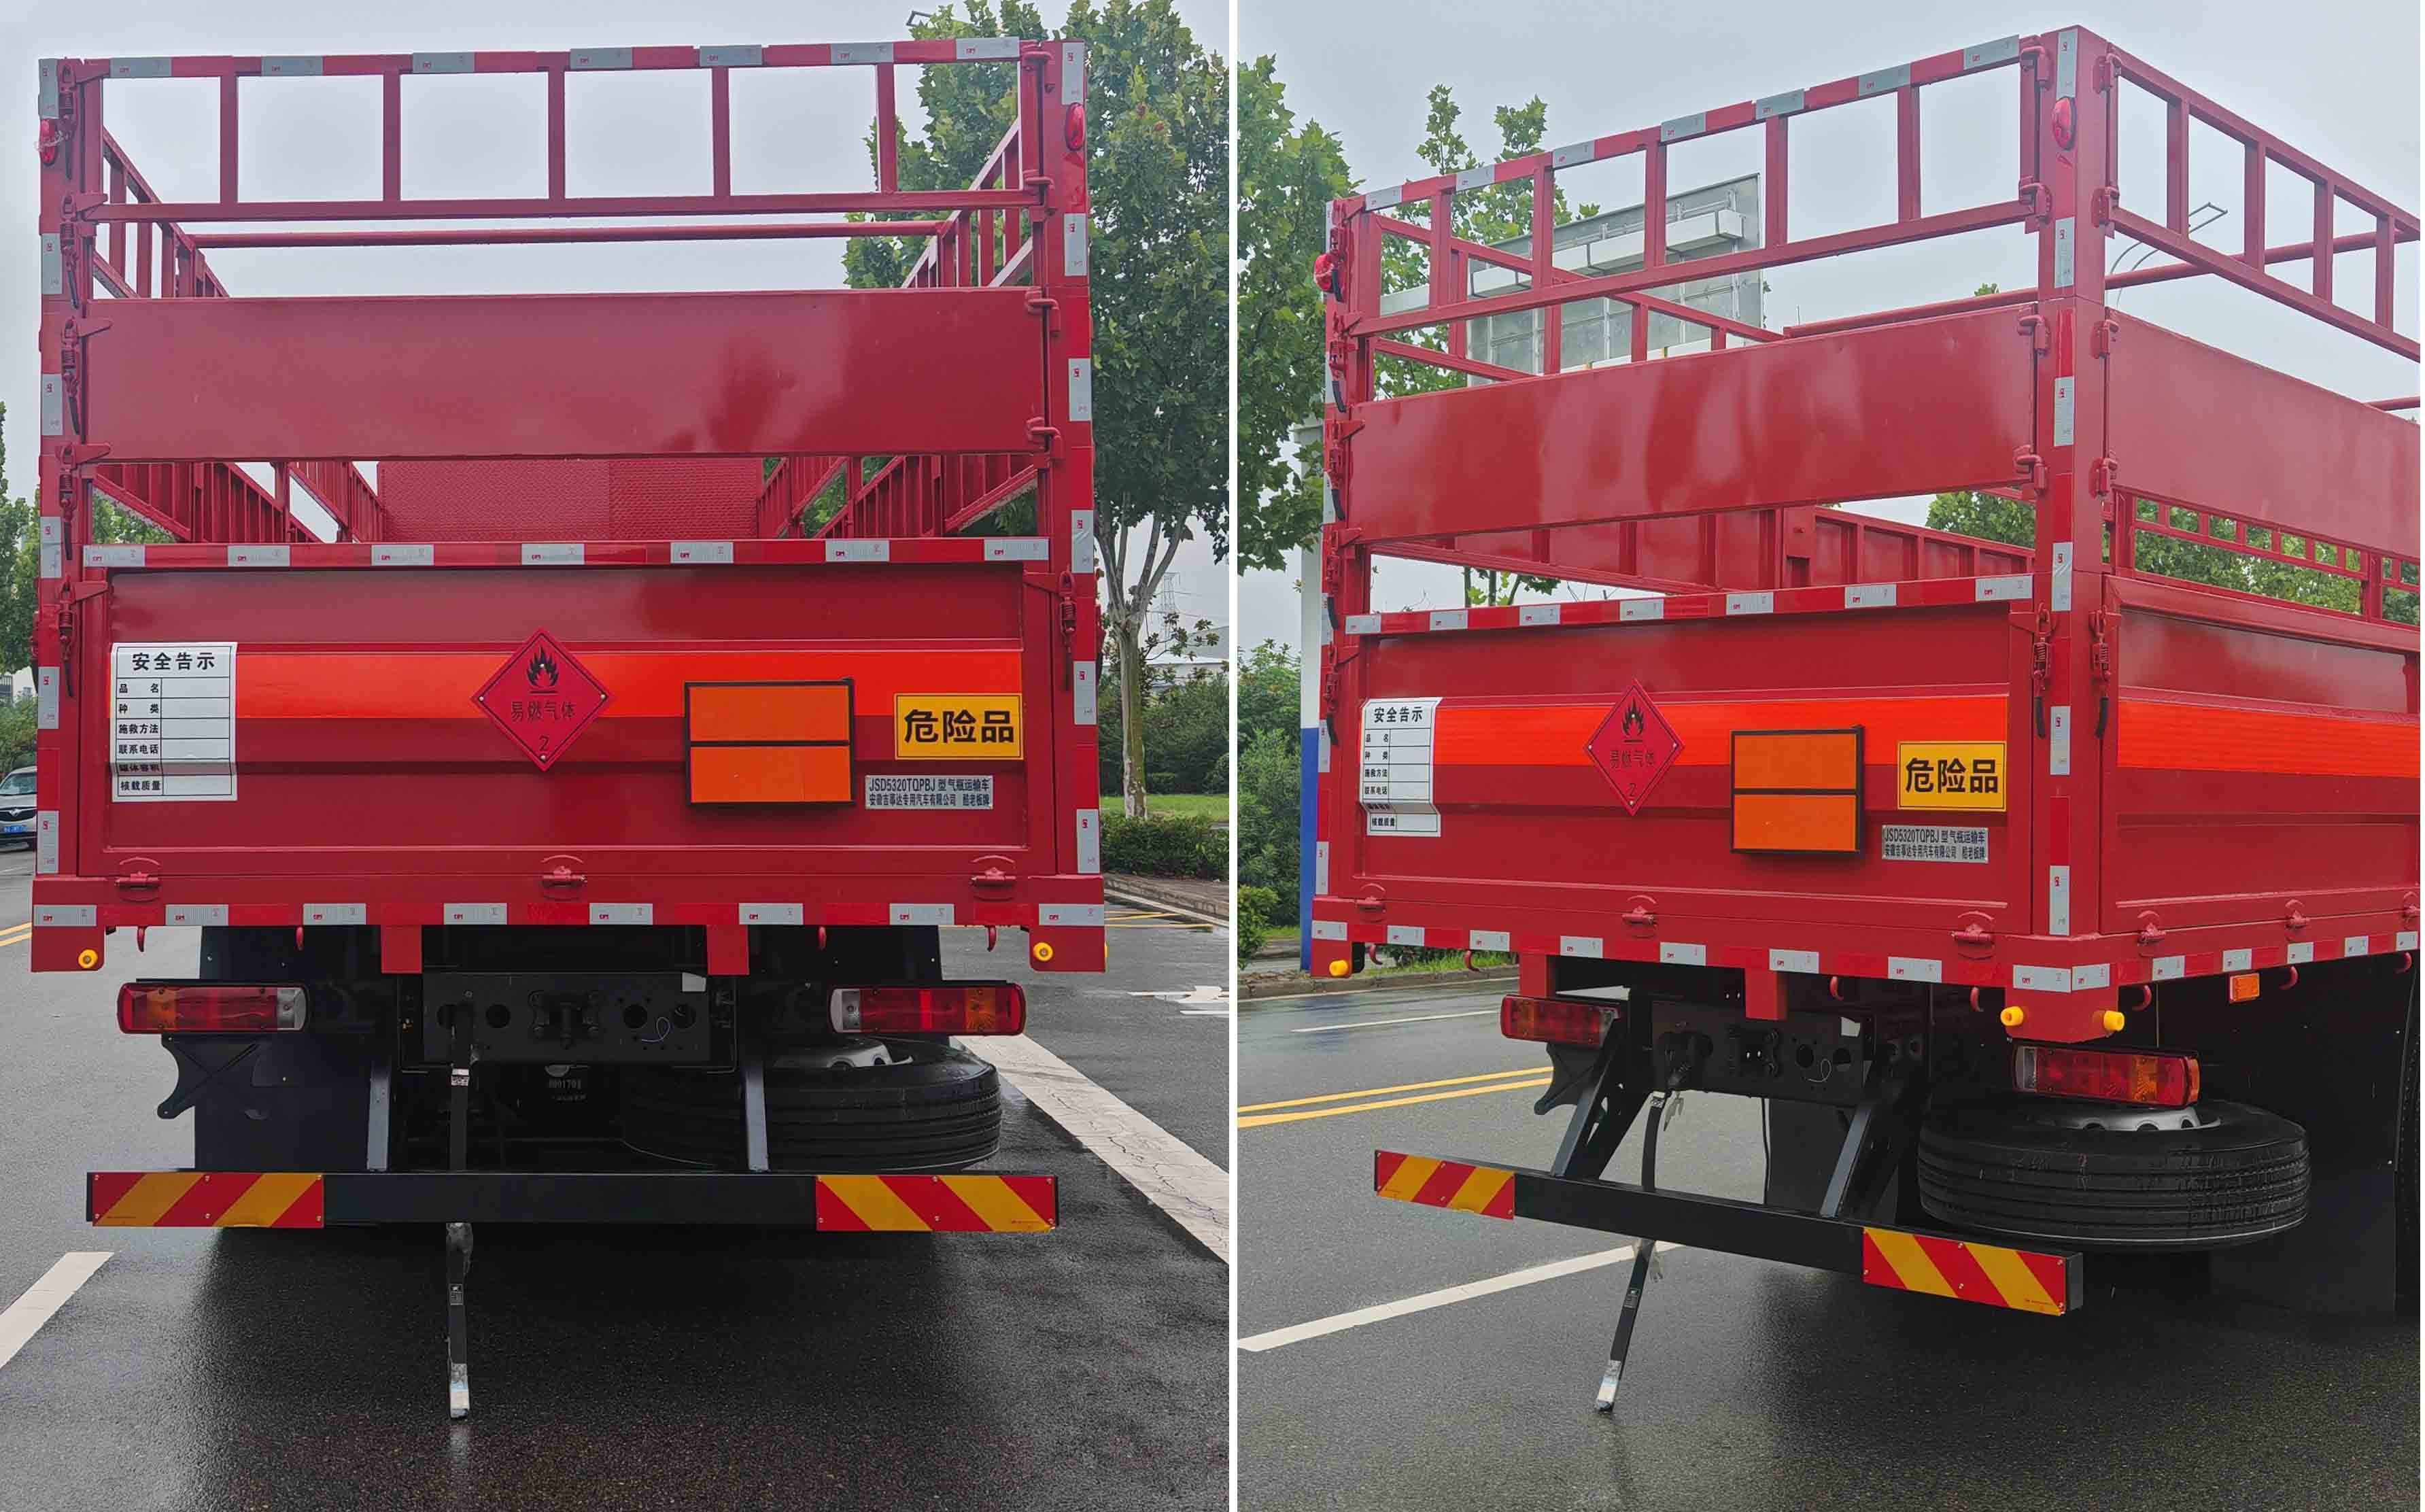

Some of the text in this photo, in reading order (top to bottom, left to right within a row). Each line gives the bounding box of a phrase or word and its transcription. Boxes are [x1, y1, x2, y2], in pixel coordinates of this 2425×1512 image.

[132, 652, 216, 671] 安全告示
[511, 701, 577, 723] 易燃气体
[1374, 706, 1423, 723] 安全告示
[118, 723, 158, 734] 施救方法
[904, 709, 1015, 744] 危险品
[118, 744, 158, 755] 联系电话
[538, 735, 550, 752] 2
[1609, 749, 1655, 769] 易燃气体
[1905, 757, 1999, 794] 危险品
[120, 780, 161, 791] 核载质量
[869, 778, 936, 792] JSD5320TQPBJ
[1628, 783, 1637, 797] 2
[1885, 827, 1940, 843] JSD5320TQPBJ
